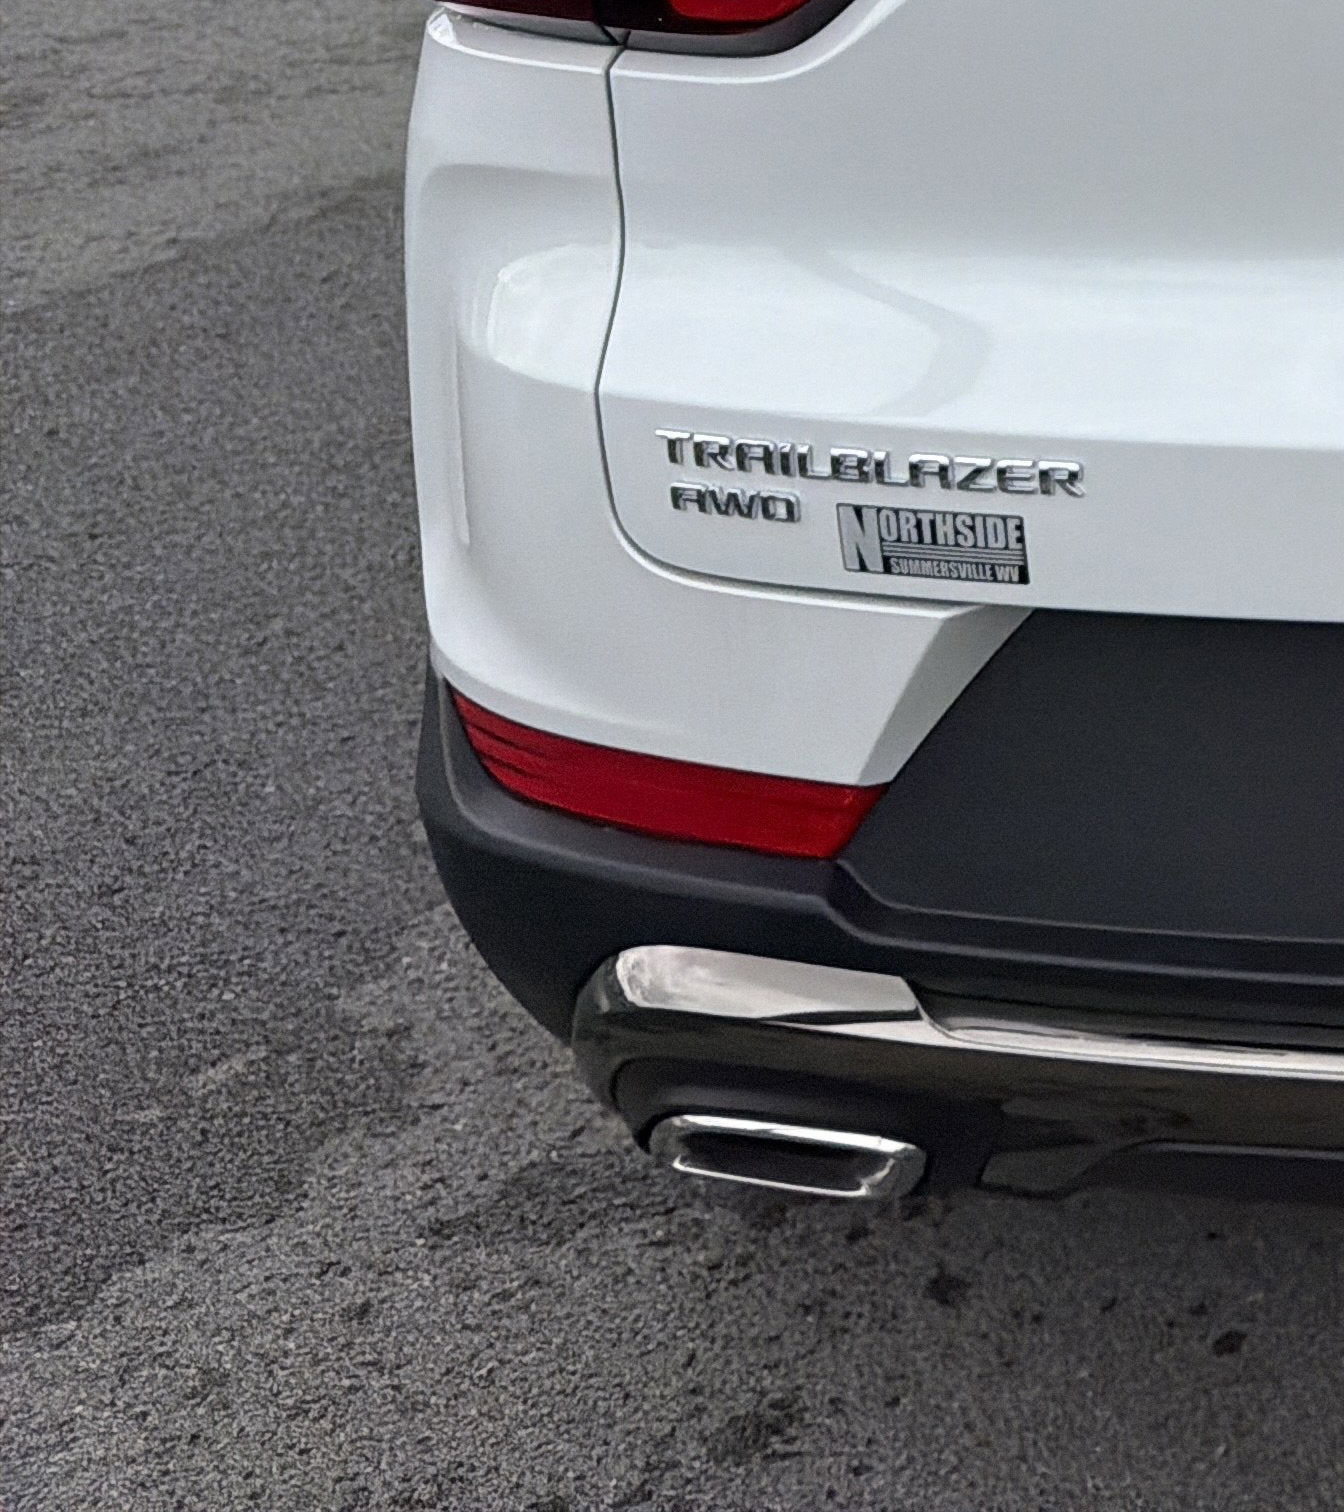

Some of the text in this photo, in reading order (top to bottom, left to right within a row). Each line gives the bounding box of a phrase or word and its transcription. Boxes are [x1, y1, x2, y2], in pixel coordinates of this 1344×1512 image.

[655, 428, 1086, 497] TRAILBLAZER
[669, 481, 801, 523] AWD
[838, 505, 1024, 572] NORTHSIDE
[889, 557, 1020, 582] SUMMERSVILLE WV
